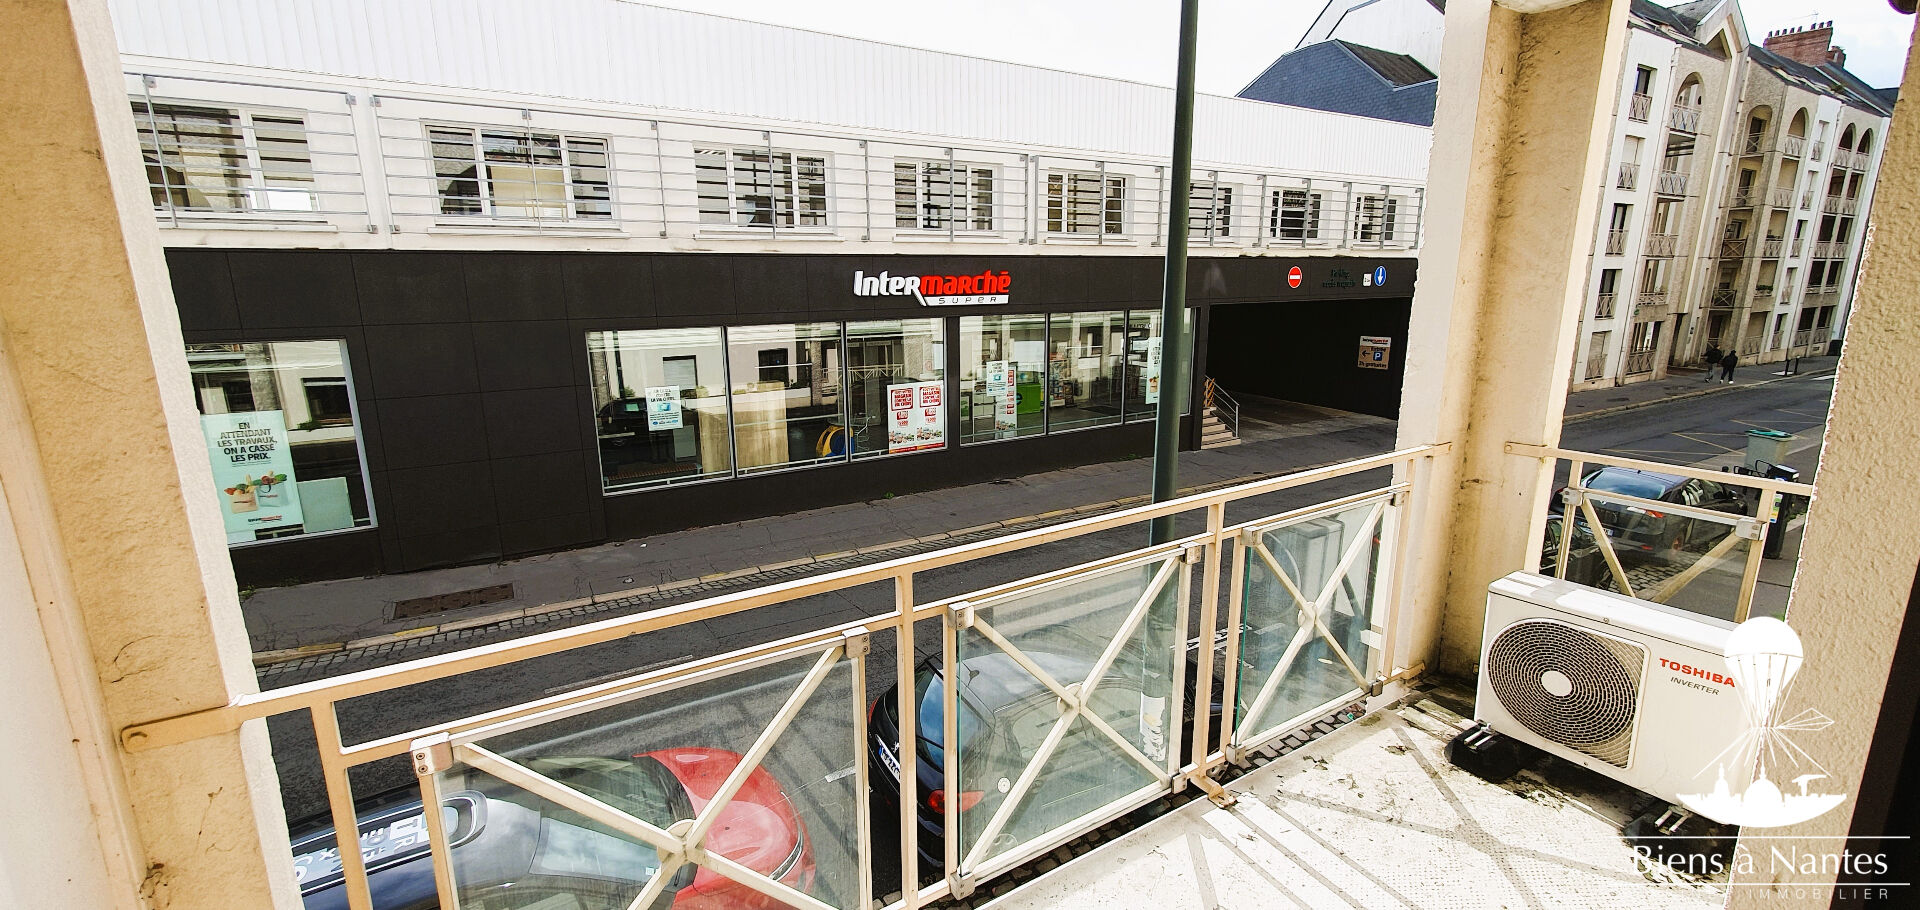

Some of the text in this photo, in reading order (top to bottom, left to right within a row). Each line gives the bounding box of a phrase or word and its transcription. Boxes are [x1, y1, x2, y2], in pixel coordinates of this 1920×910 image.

[854, 270, 1011, 306] Intermarché
[938, 296, 996, 304] SUPER
[220, 429, 271, 439] ATTENDANT
[236, 436, 277, 446] TRAVAUX,
[240, 446, 246, 454] A
[248, 452, 271, 461] PRIX.
[1660, 658, 1736, 688] TOSHIBA
[1670, 676, 1720, 695] INVERTER
